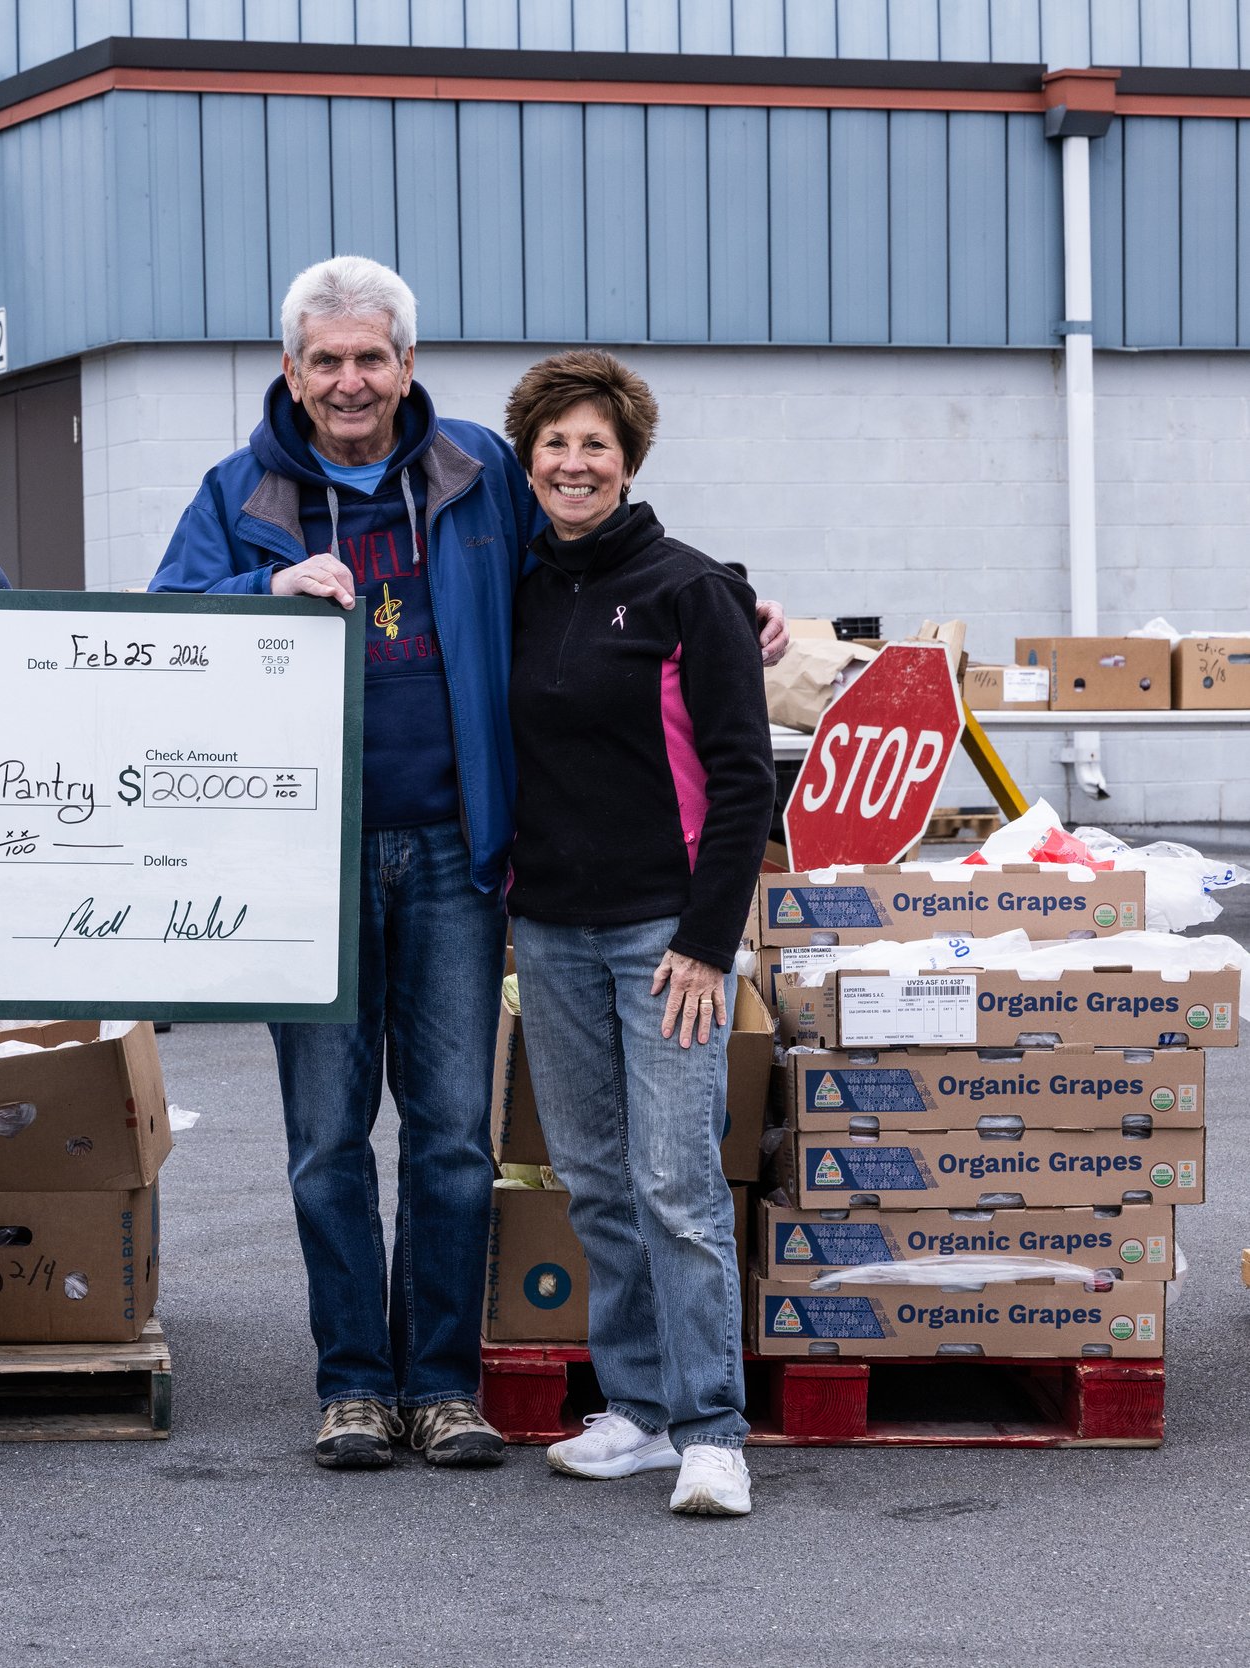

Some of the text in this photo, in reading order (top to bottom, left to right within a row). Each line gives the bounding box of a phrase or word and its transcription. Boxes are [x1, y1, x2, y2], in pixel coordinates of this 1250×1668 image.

[71, 634, 209, 668] Feb 25 2026
[257, 638, 295, 650] 02001
[27, 658, 58, 670] Date
[261, 655, 290, 665] 75-53
[265, 666, 285, 675] 919
[145, 749, 238, 762] Check Amount
[118, 764, 142, 806] $
[803, 723, 944, 821] STOP
[152, 771, 268, 803] 20,000
[144, 854, 188, 867] Dollars
[892, 891, 1087, 918] Organic Grapes
[977, 992, 1179, 1019] Organic Grapes
[937, 1073, 1144, 1101] Organic Grapes
[938, 1151, 1143, 1180] Organic Grapes
[907, 1230, 1113, 1257] Organic Grapes
[897, 1303, 1102, 1331] Organic Grapes
